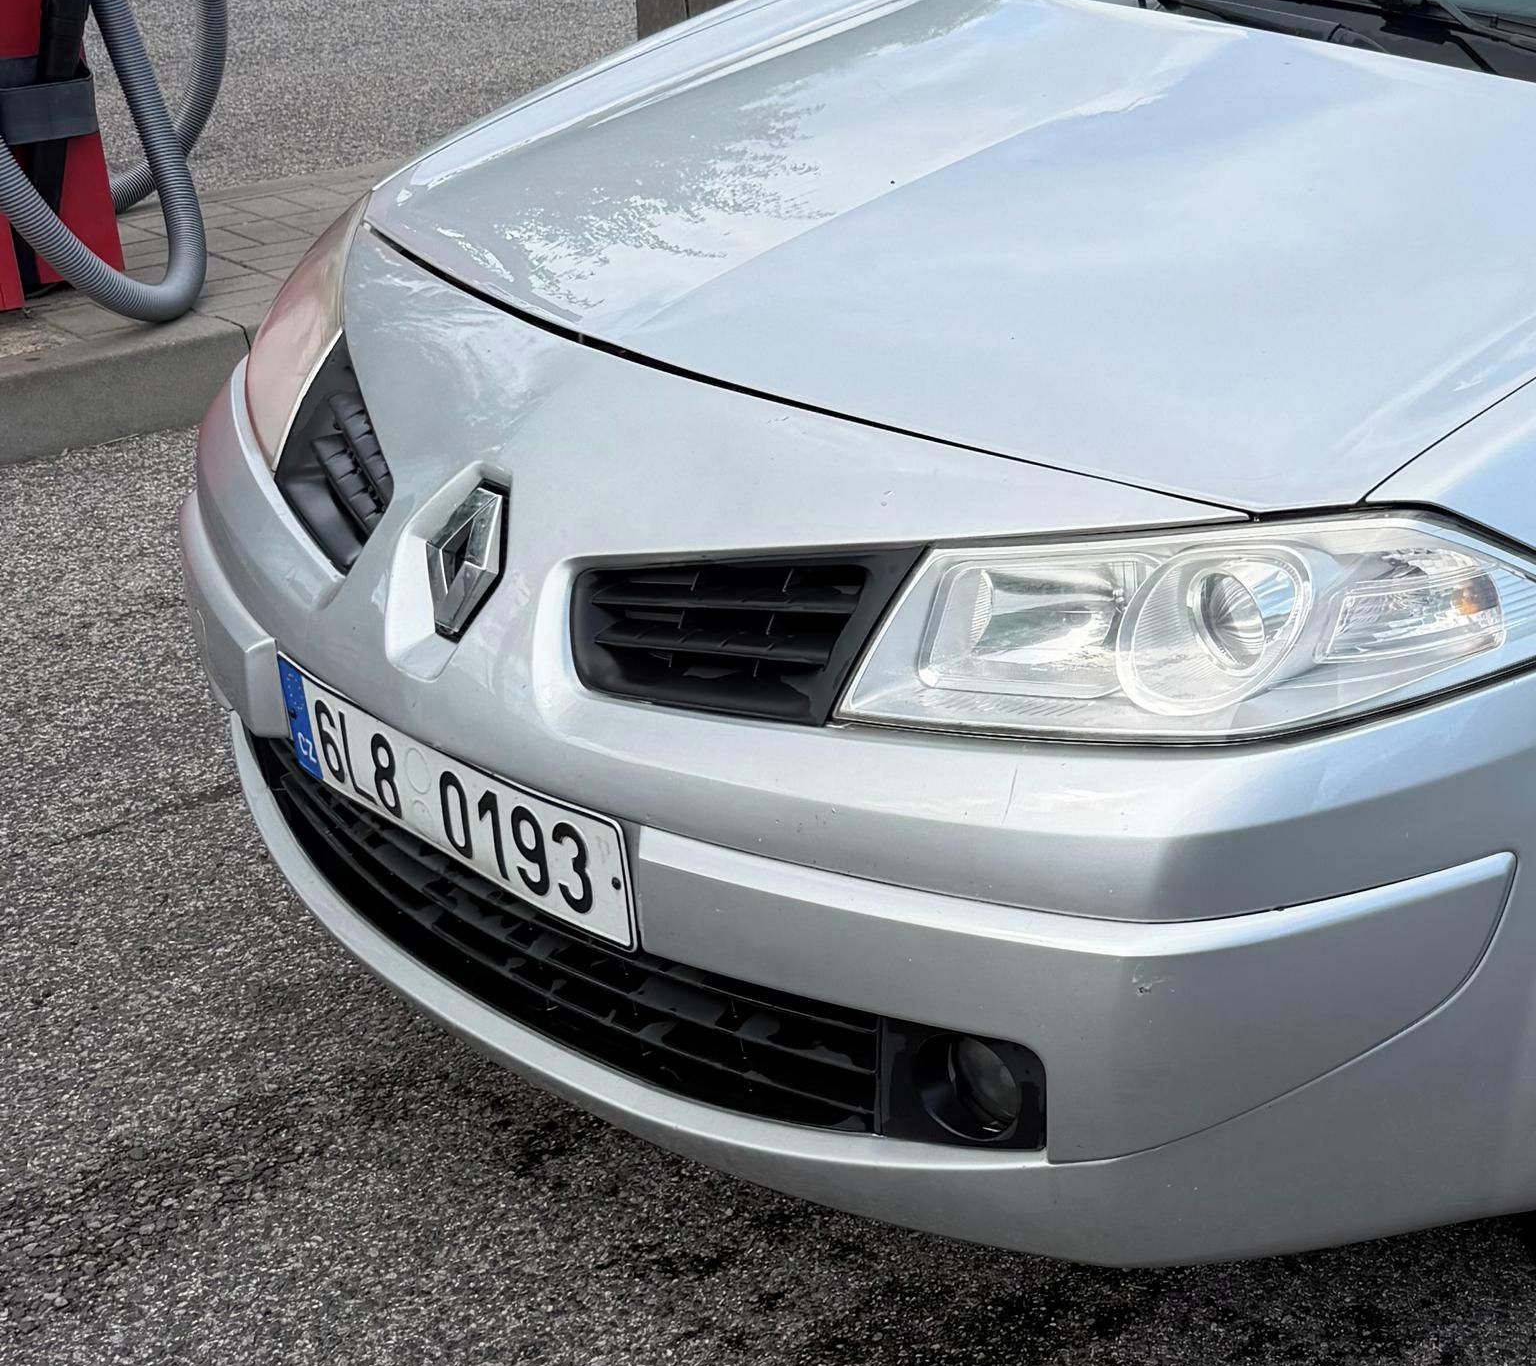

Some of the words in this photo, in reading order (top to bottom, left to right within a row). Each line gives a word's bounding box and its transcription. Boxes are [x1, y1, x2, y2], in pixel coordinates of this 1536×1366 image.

[297, 731, 318, 764] CZ
[314, 699, 402, 820] 6L8
[439, 770, 594, 915] 0193
